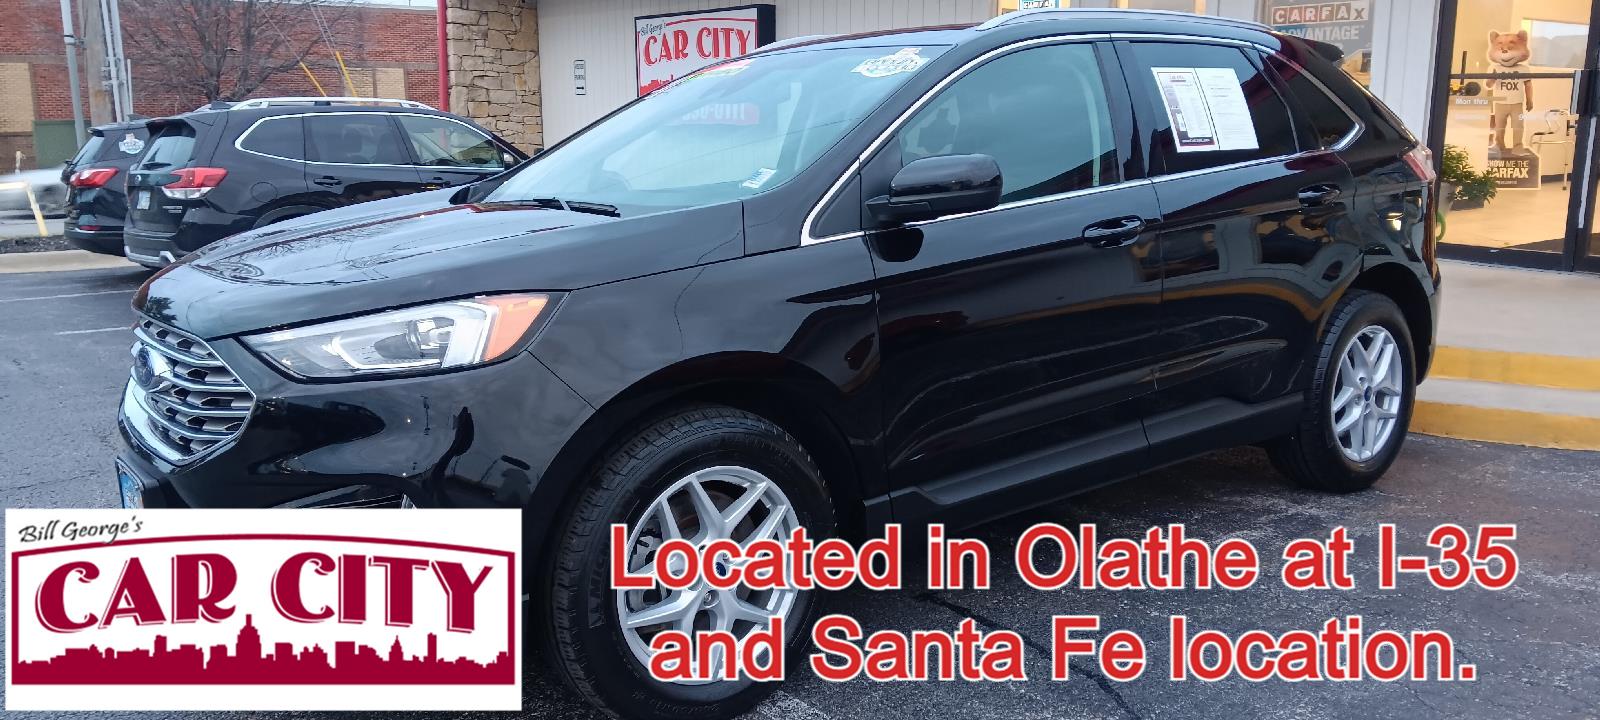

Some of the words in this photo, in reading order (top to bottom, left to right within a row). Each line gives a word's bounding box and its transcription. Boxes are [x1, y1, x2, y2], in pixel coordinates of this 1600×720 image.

[1274, 5, 1366, 22] CARFAX
[1281, 25, 1360, 41] DVANTAGE
[644, 29, 689, 66] CAR
[696, 26, 751, 59] CITY
[1500, 82, 1519, 91] FOX
[1505, 160, 1516, 168] ME
[1516, 160, 1529, 168] THE
